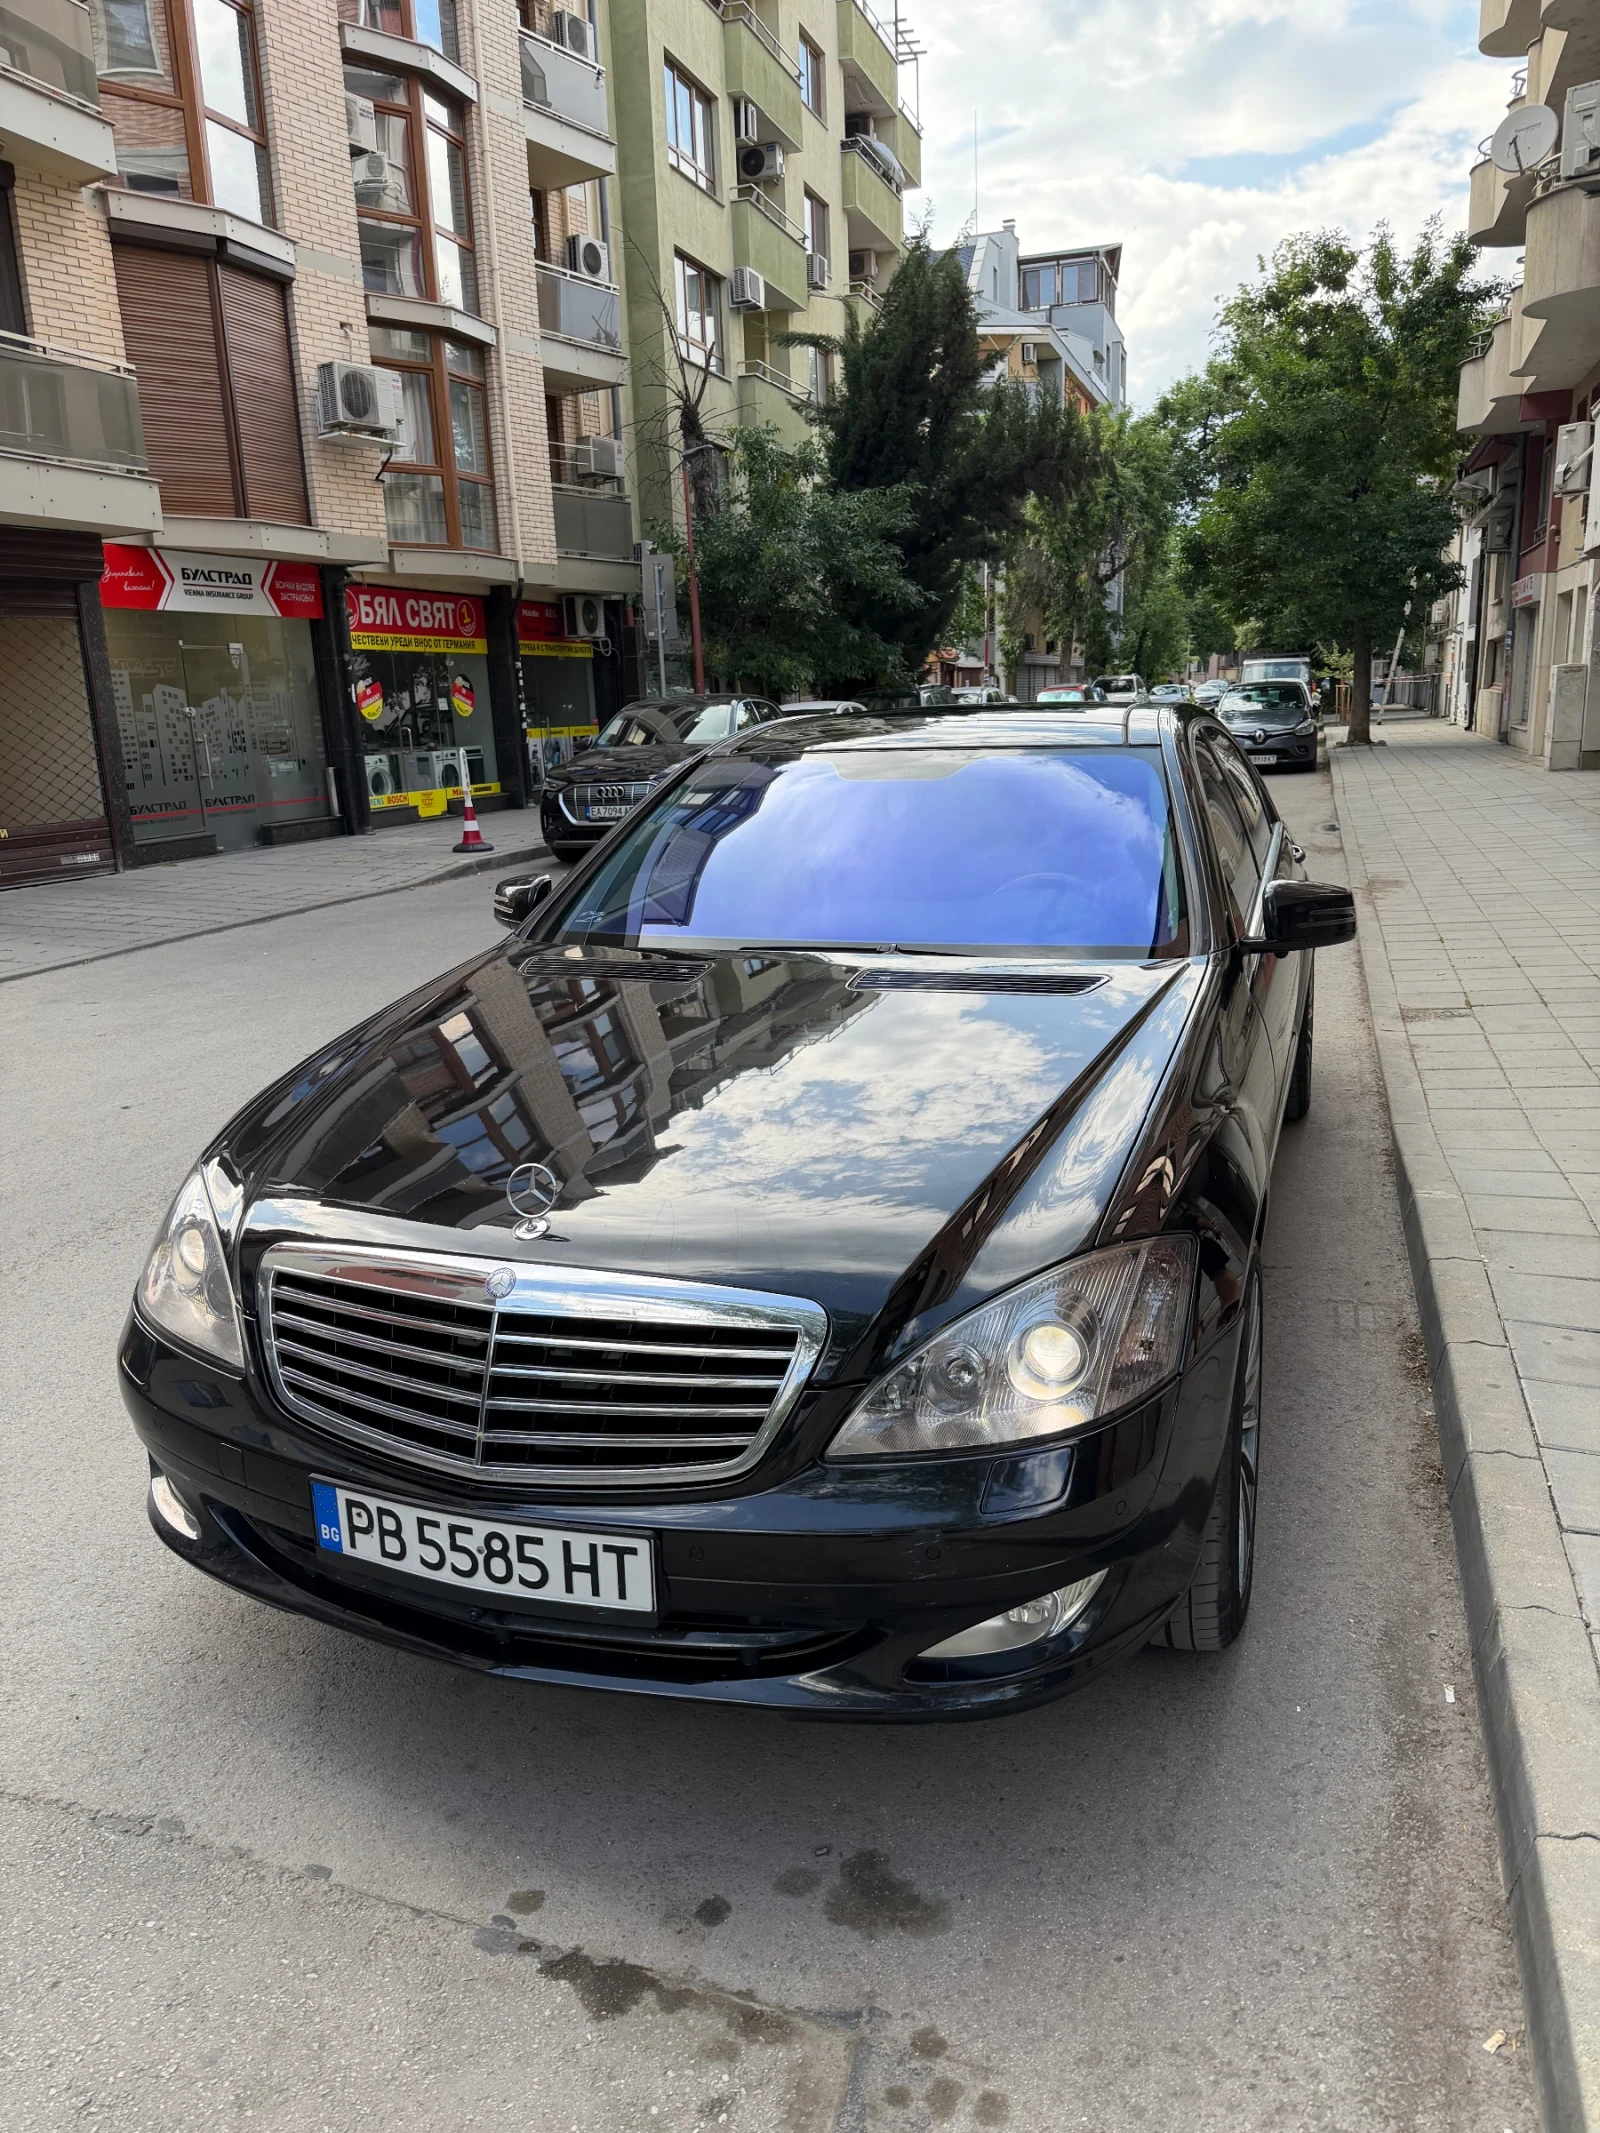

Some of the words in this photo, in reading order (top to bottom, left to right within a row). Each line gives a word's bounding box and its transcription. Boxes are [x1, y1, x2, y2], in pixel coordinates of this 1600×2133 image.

[181, 567, 253, 585] БУЛСТРАД
[275, 580, 295, 589] ВСИЧКИ
[296, 582, 316, 592] ВИДОВЕ
[184, 588, 204, 597] VIENNA
[205, 590, 235, 599] INSURANCE
[236, 592, 254, 600] GROUP
[280, 592, 314, 602] ЗАСТРАХОВКИ
[359, 594, 402, 626] БЯЛ
[406, 599, 455, 629] СВЯТ
[352, 634, 389, 646] ЧЕСТВЕНИ
[390, 636, 412, 648] УРЕДИ
[414, 638, 433, 648] ВНОС
[434, 639, 441, 648] ОТ
[443, 639, 476, 650] ГЕРМАНИЯ
[205, 794, 255, 807] БУЛСТРАД
[387, 795, 408, 805] BOSCH
[130, 801, 187, 815] БУЛСТРАД
[591, 807, 602, 816] EA
[602, 806, 622, 816] 7094
[321, 1524, 340, 1542] BG
[345, 1498, 407, 1561] PB
[416, 1516, 549, 1590] 5585
[562, 1540, 638, 1600] HT
